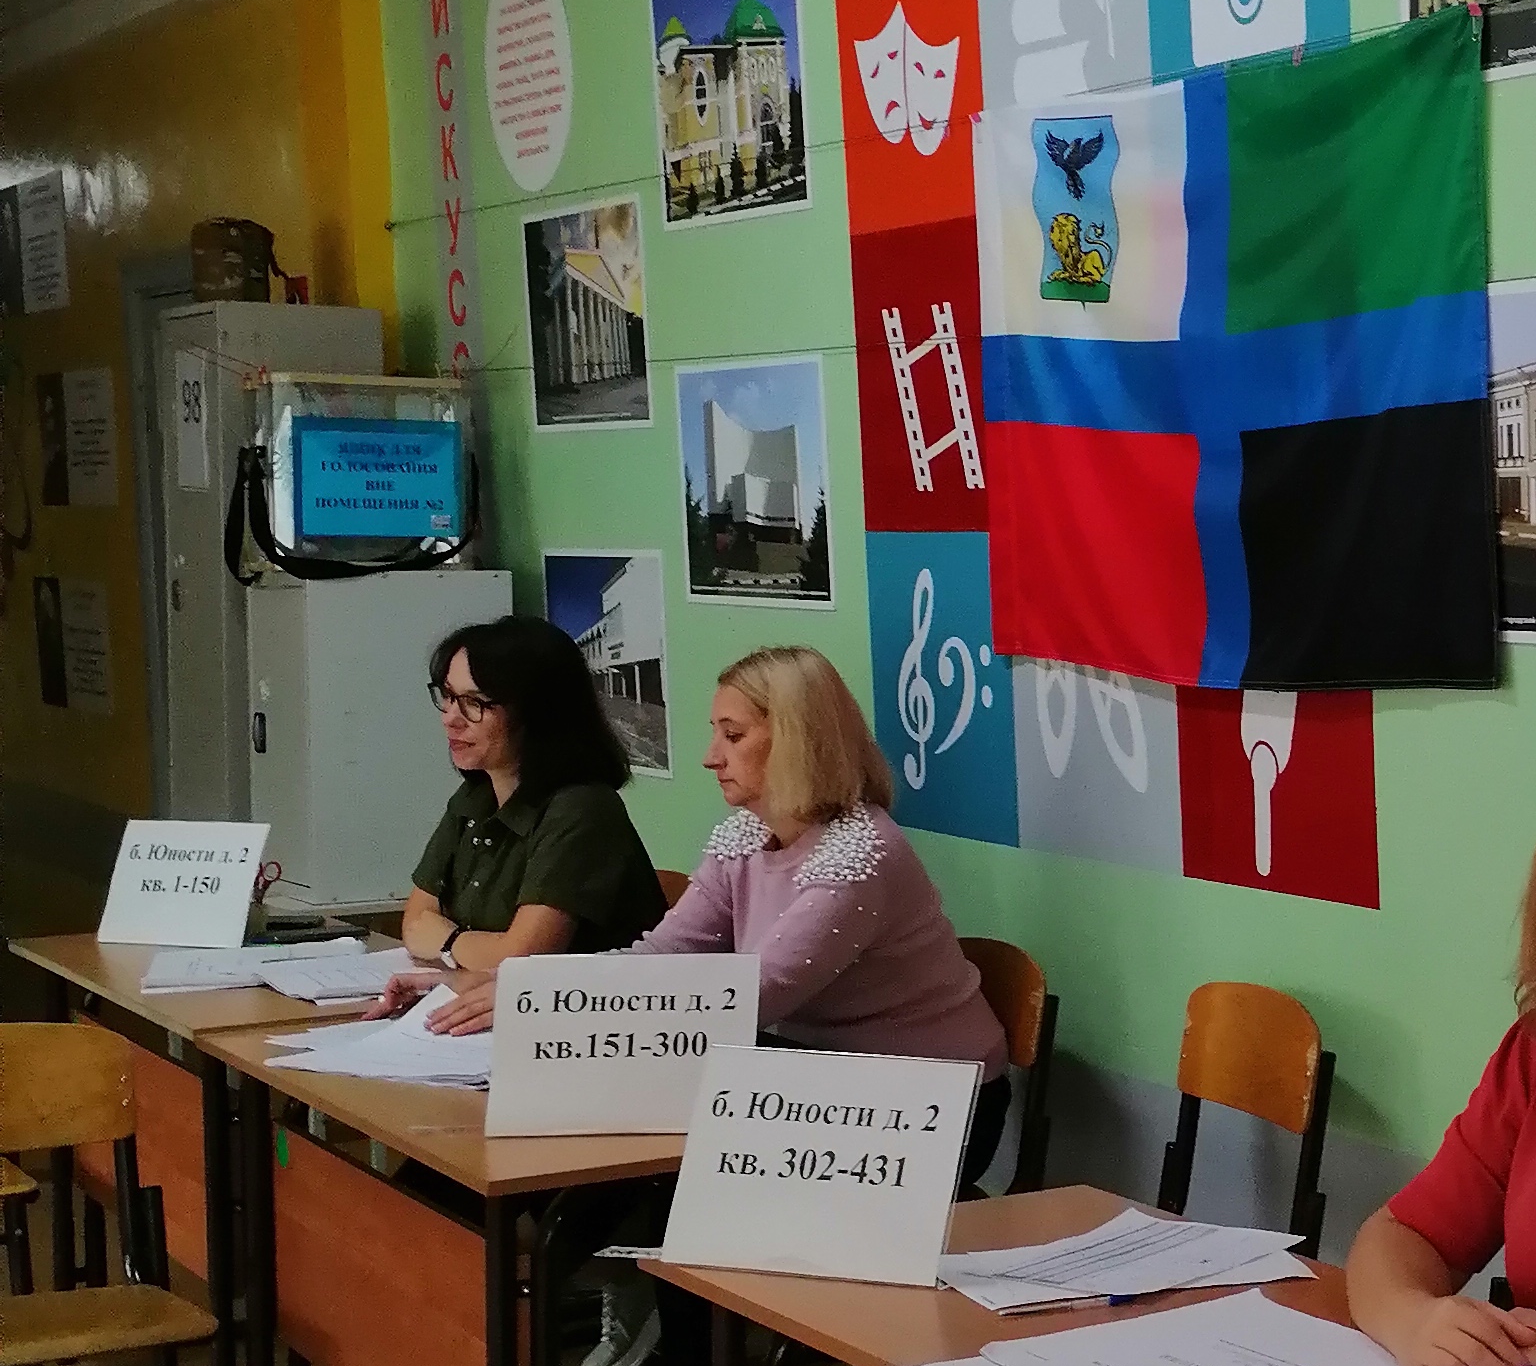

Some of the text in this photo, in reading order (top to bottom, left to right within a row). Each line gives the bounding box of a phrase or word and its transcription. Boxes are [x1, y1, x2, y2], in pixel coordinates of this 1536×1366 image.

[181, 378, 202, 425] 98
[321, 460, 438, 474] ГОЛОСОВАНИЯ
[365, 479, 397, 492] ВНЕ
[314, 497, 419, 510] ПОМЕЩЕНИЯ
[147, 843, 214, 863] Юности
[239, 846, 250, 864] 2
[140, 874, 222, 896] кв. 1-150
[516, 987, 738, 1015] б. Юности д. 2
[533, 1030, 709, 1062] кв.151-300
[711, 1089, 942, 1135] б. Юности д. 2
[716, 1147, 909, 1190] кв. 302-431
